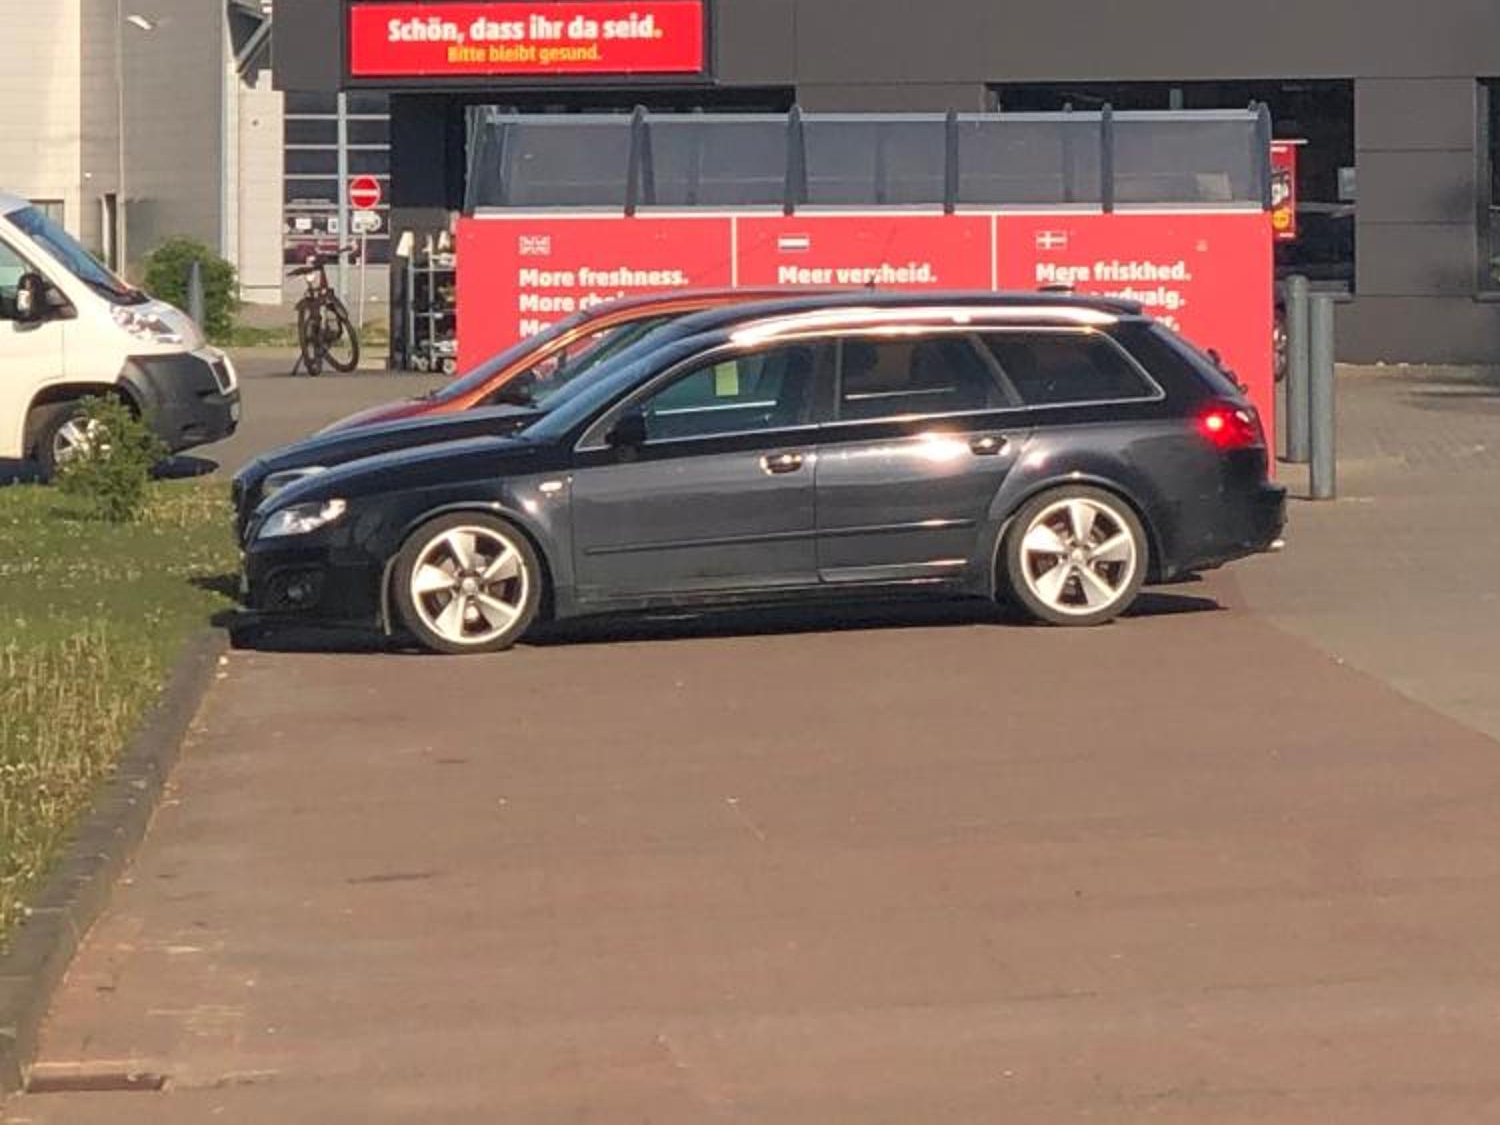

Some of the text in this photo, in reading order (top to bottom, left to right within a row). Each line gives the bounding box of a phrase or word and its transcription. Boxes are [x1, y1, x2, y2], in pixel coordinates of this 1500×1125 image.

[387, 11, 663, 43] Schön, dass ihr da seid.
[447, 43, 602, 65] Bitte bleibt gesund.
[519, 266, 689, 287] More freshness.
[778, 266, 832, 284] Meer
[1035, 260, 1191, 282] Mere friskhed.
[519, 294, 575, 312] More
